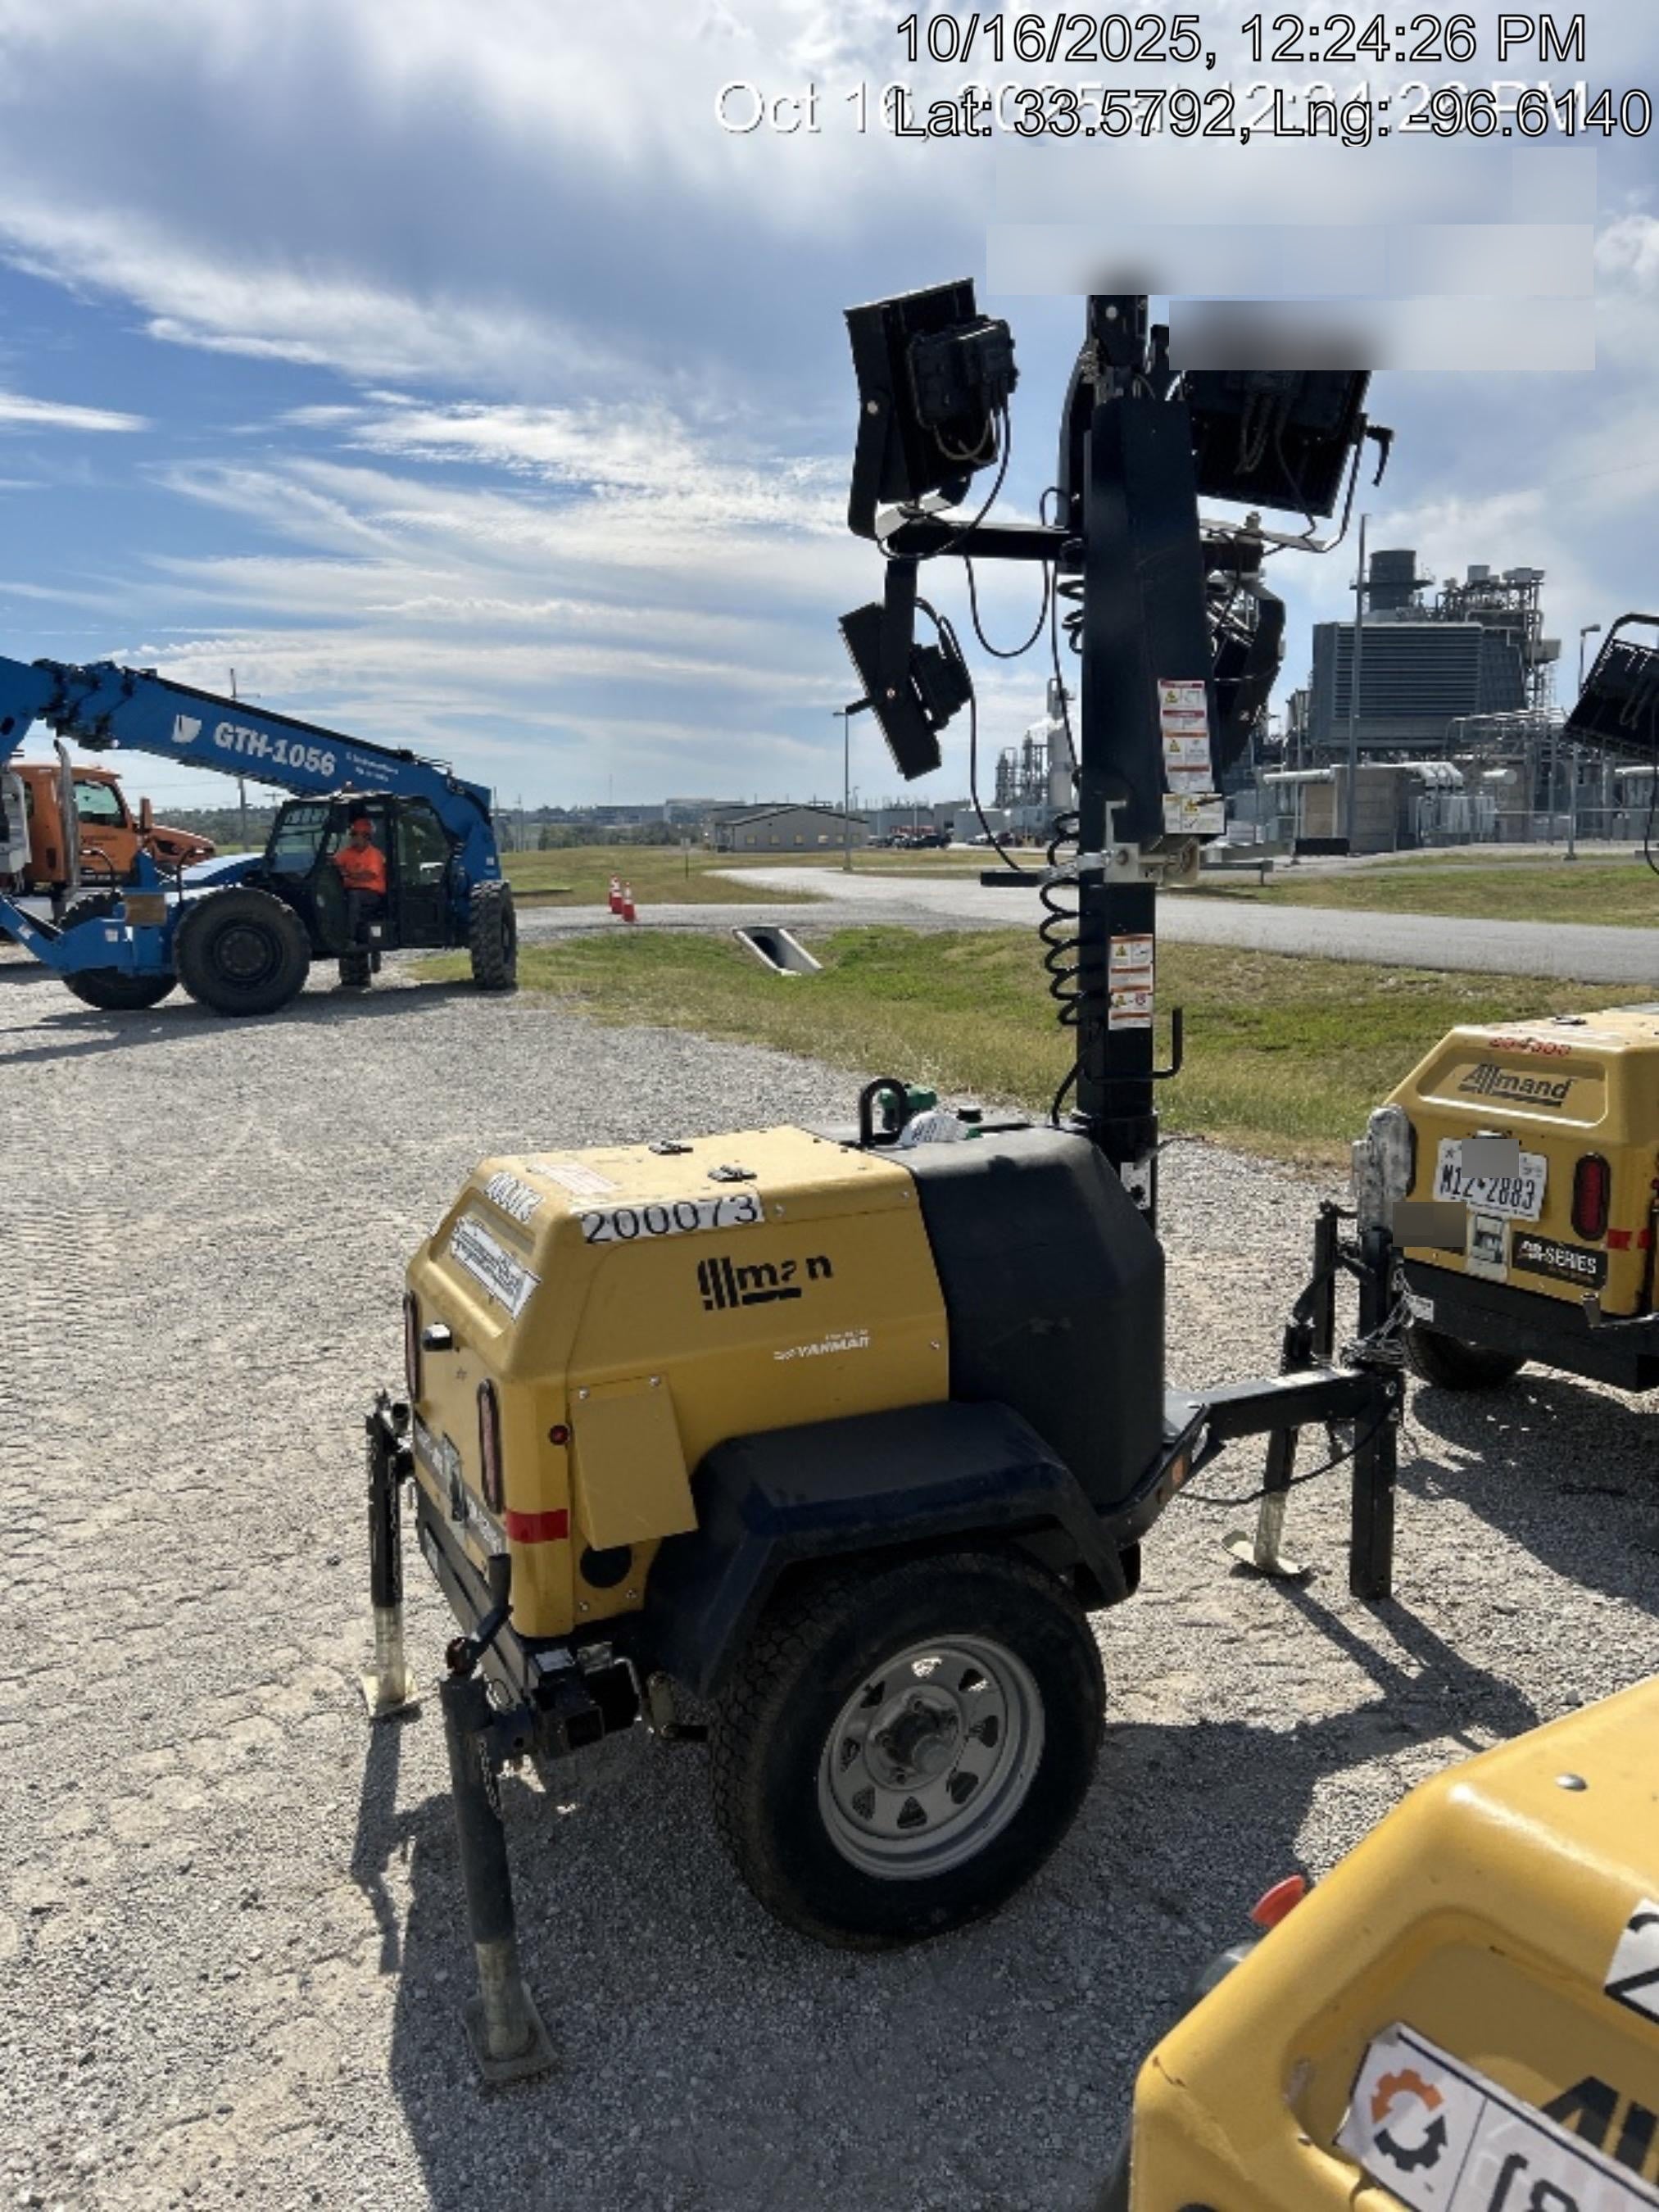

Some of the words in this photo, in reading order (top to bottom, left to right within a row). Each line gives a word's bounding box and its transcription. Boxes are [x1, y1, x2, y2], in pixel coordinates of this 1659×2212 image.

[215, 721, 336, 777] GTH-1056
[1462, 1063, 1576, 1104] Allmand
[581, 1194, 758, 1245] 200073
